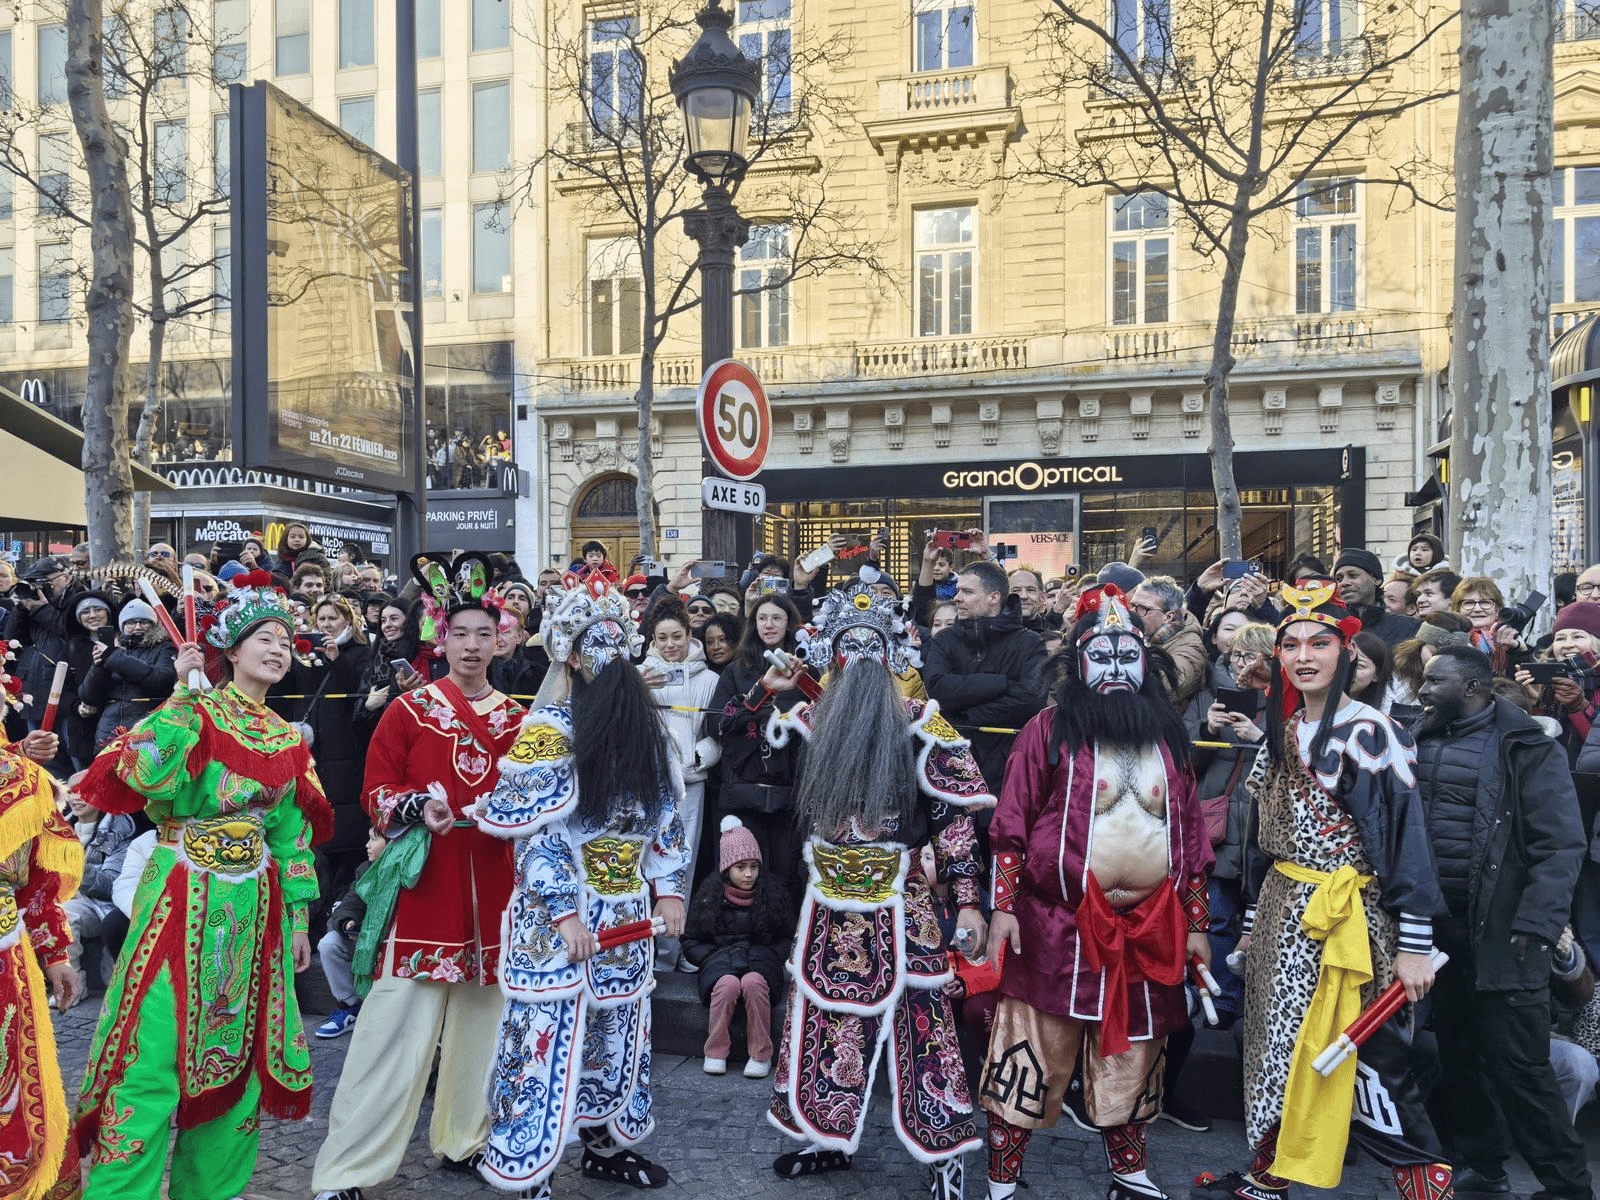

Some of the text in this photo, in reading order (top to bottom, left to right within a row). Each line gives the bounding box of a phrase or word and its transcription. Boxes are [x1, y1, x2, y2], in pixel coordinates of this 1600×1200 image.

[718, 393, 757, 449] 50
[309, 429, 398, 460] LES 21 ET 22 FÉVRIER 2025
[335, 466, 364, 479] JCDecaux
[712, 485, 760, 507] AXE 50
[425, 508, 494, 522] PARKING PRIVÉ
[207, 520, 240, 531] McDo
[456, 522, 494, 530] JOUR & NUIT
[195, 528, 251, 541] Mercato
[1030, 534, 1070, 543] VERSACE
[322, 536, 344, 548] McDo
